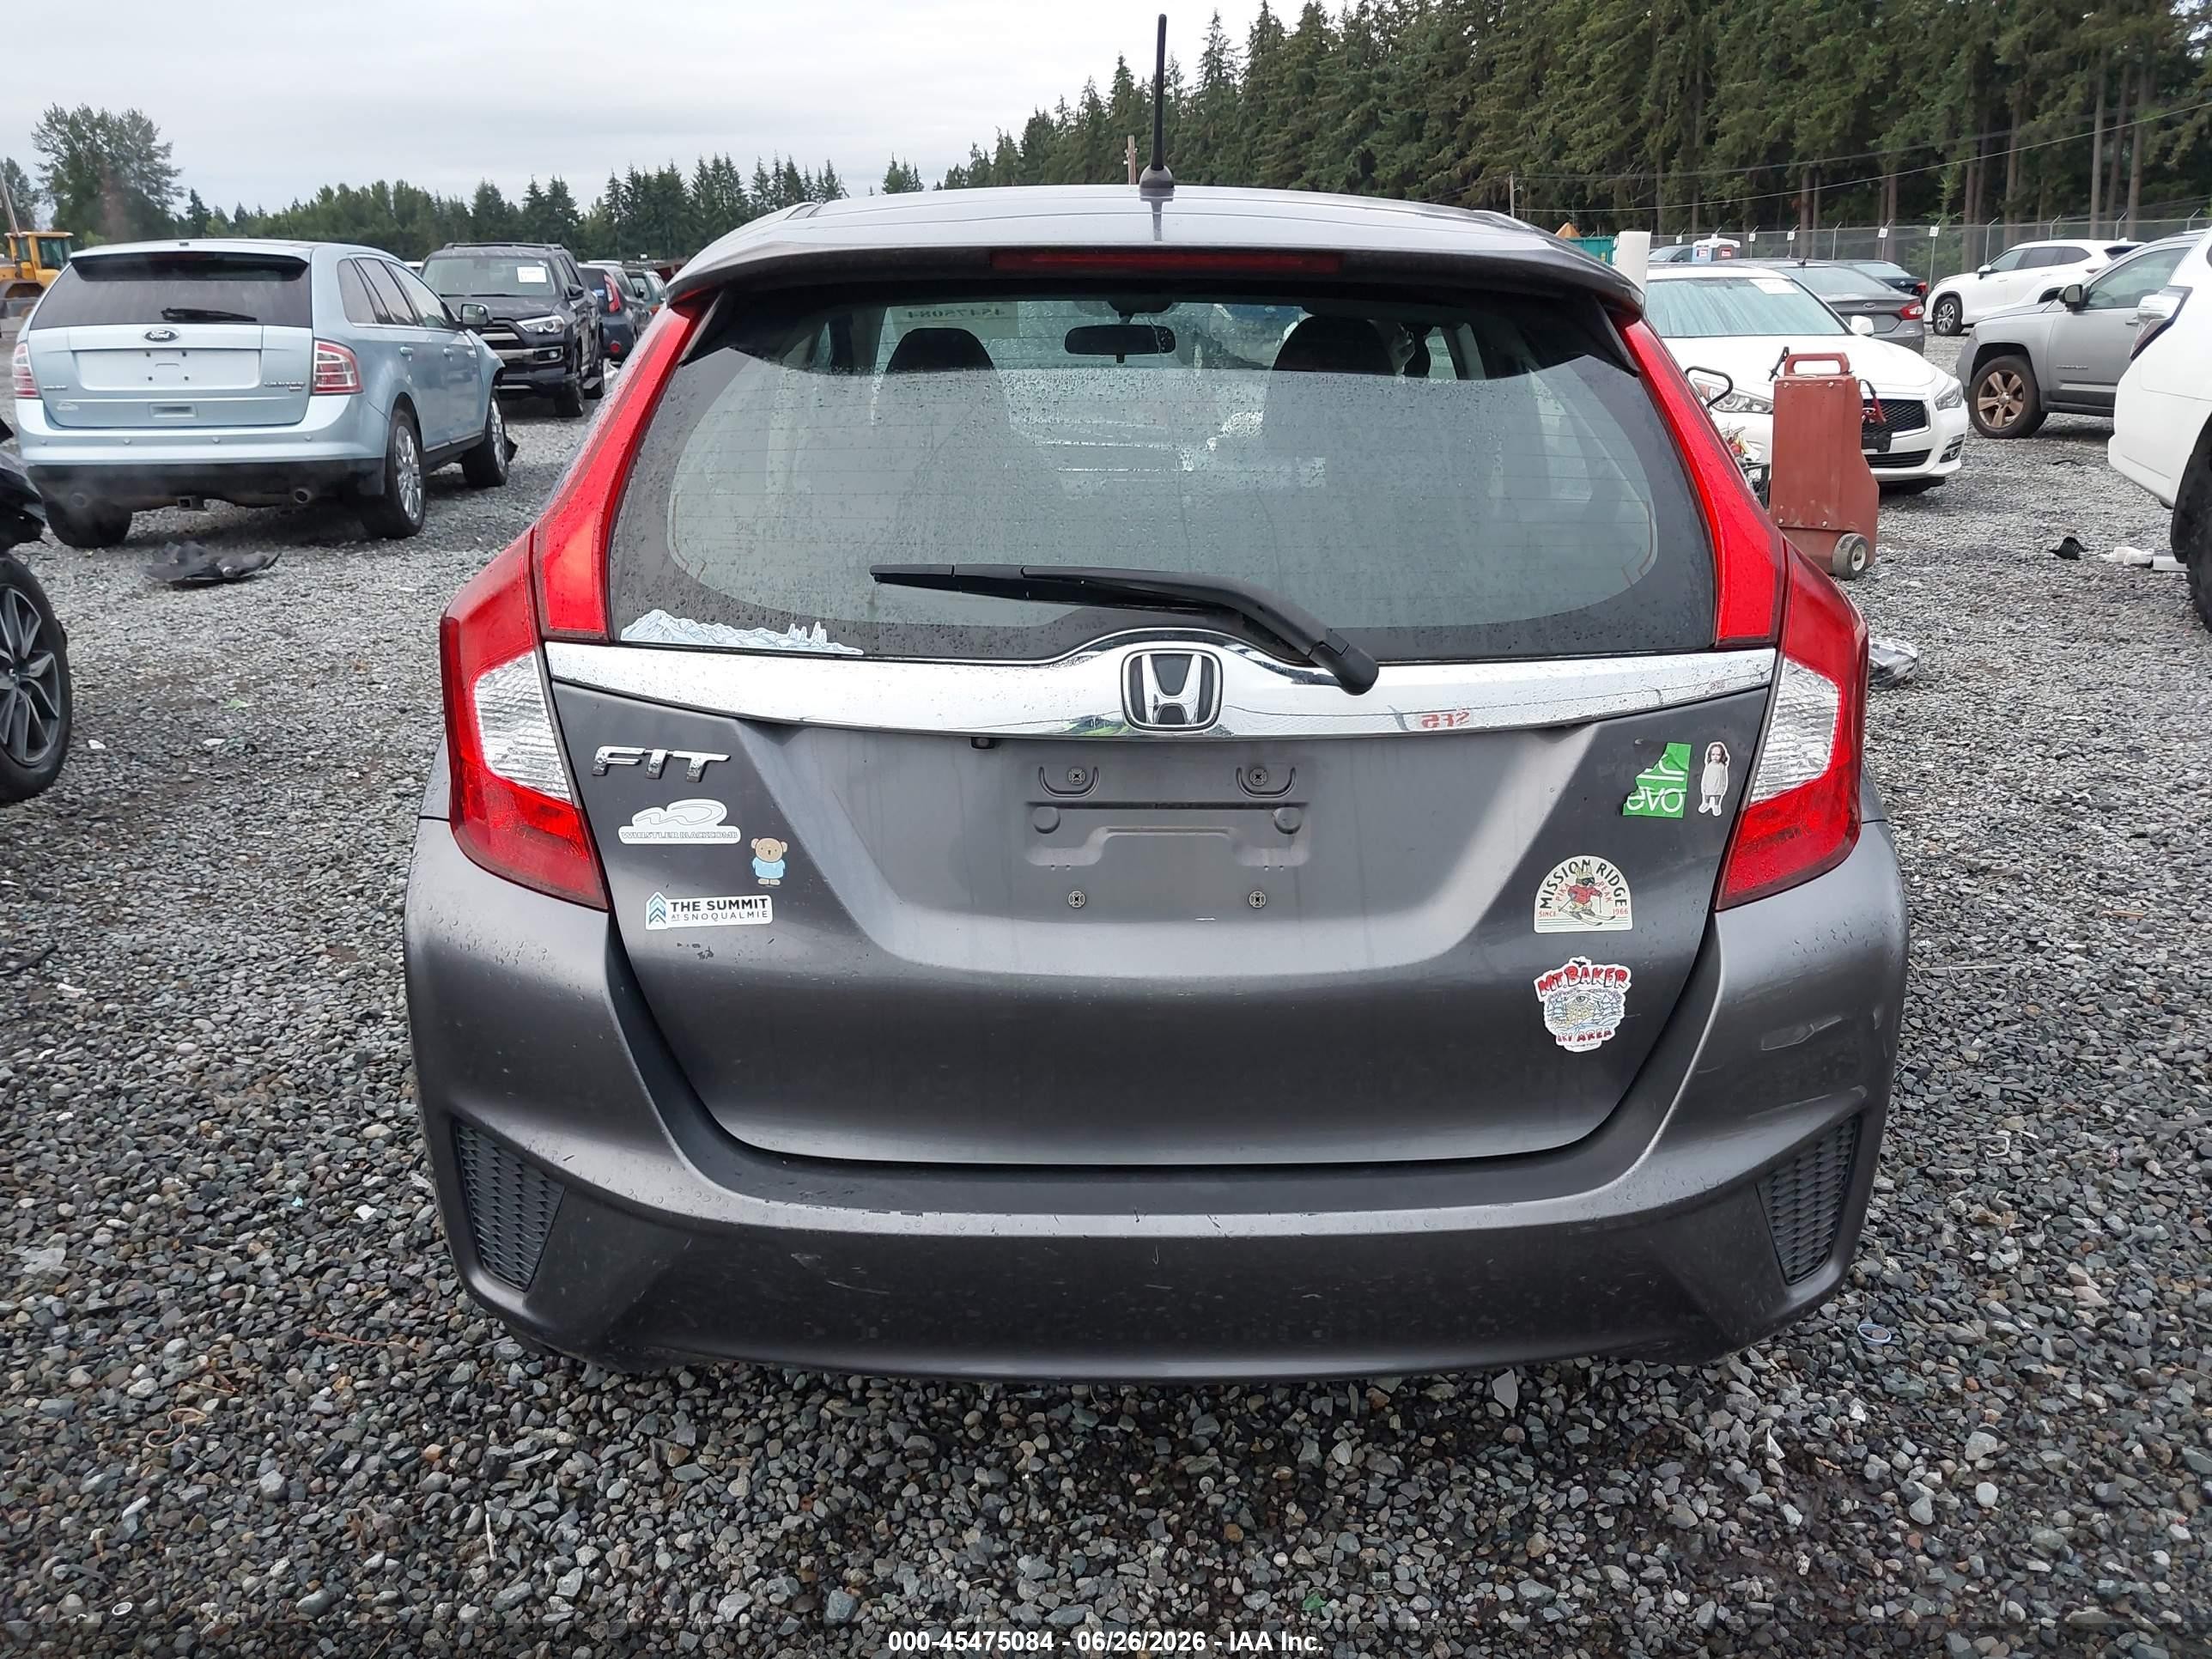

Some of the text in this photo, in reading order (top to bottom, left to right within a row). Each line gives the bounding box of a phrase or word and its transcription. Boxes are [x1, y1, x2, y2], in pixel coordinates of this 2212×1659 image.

[592, 745, 730, 783] FIT
[1626, 787, 1684, 813] evo
[1540, 859, 1627, 909] MISSION RIDGE
[671, 898, 768, 913] THE SUMMIT
[684, 910, 768, 921] SNOQUALMIE
[1565, 966, 1628, 989] BAKER
[1577, 1027, 1612, 1042] AREA
